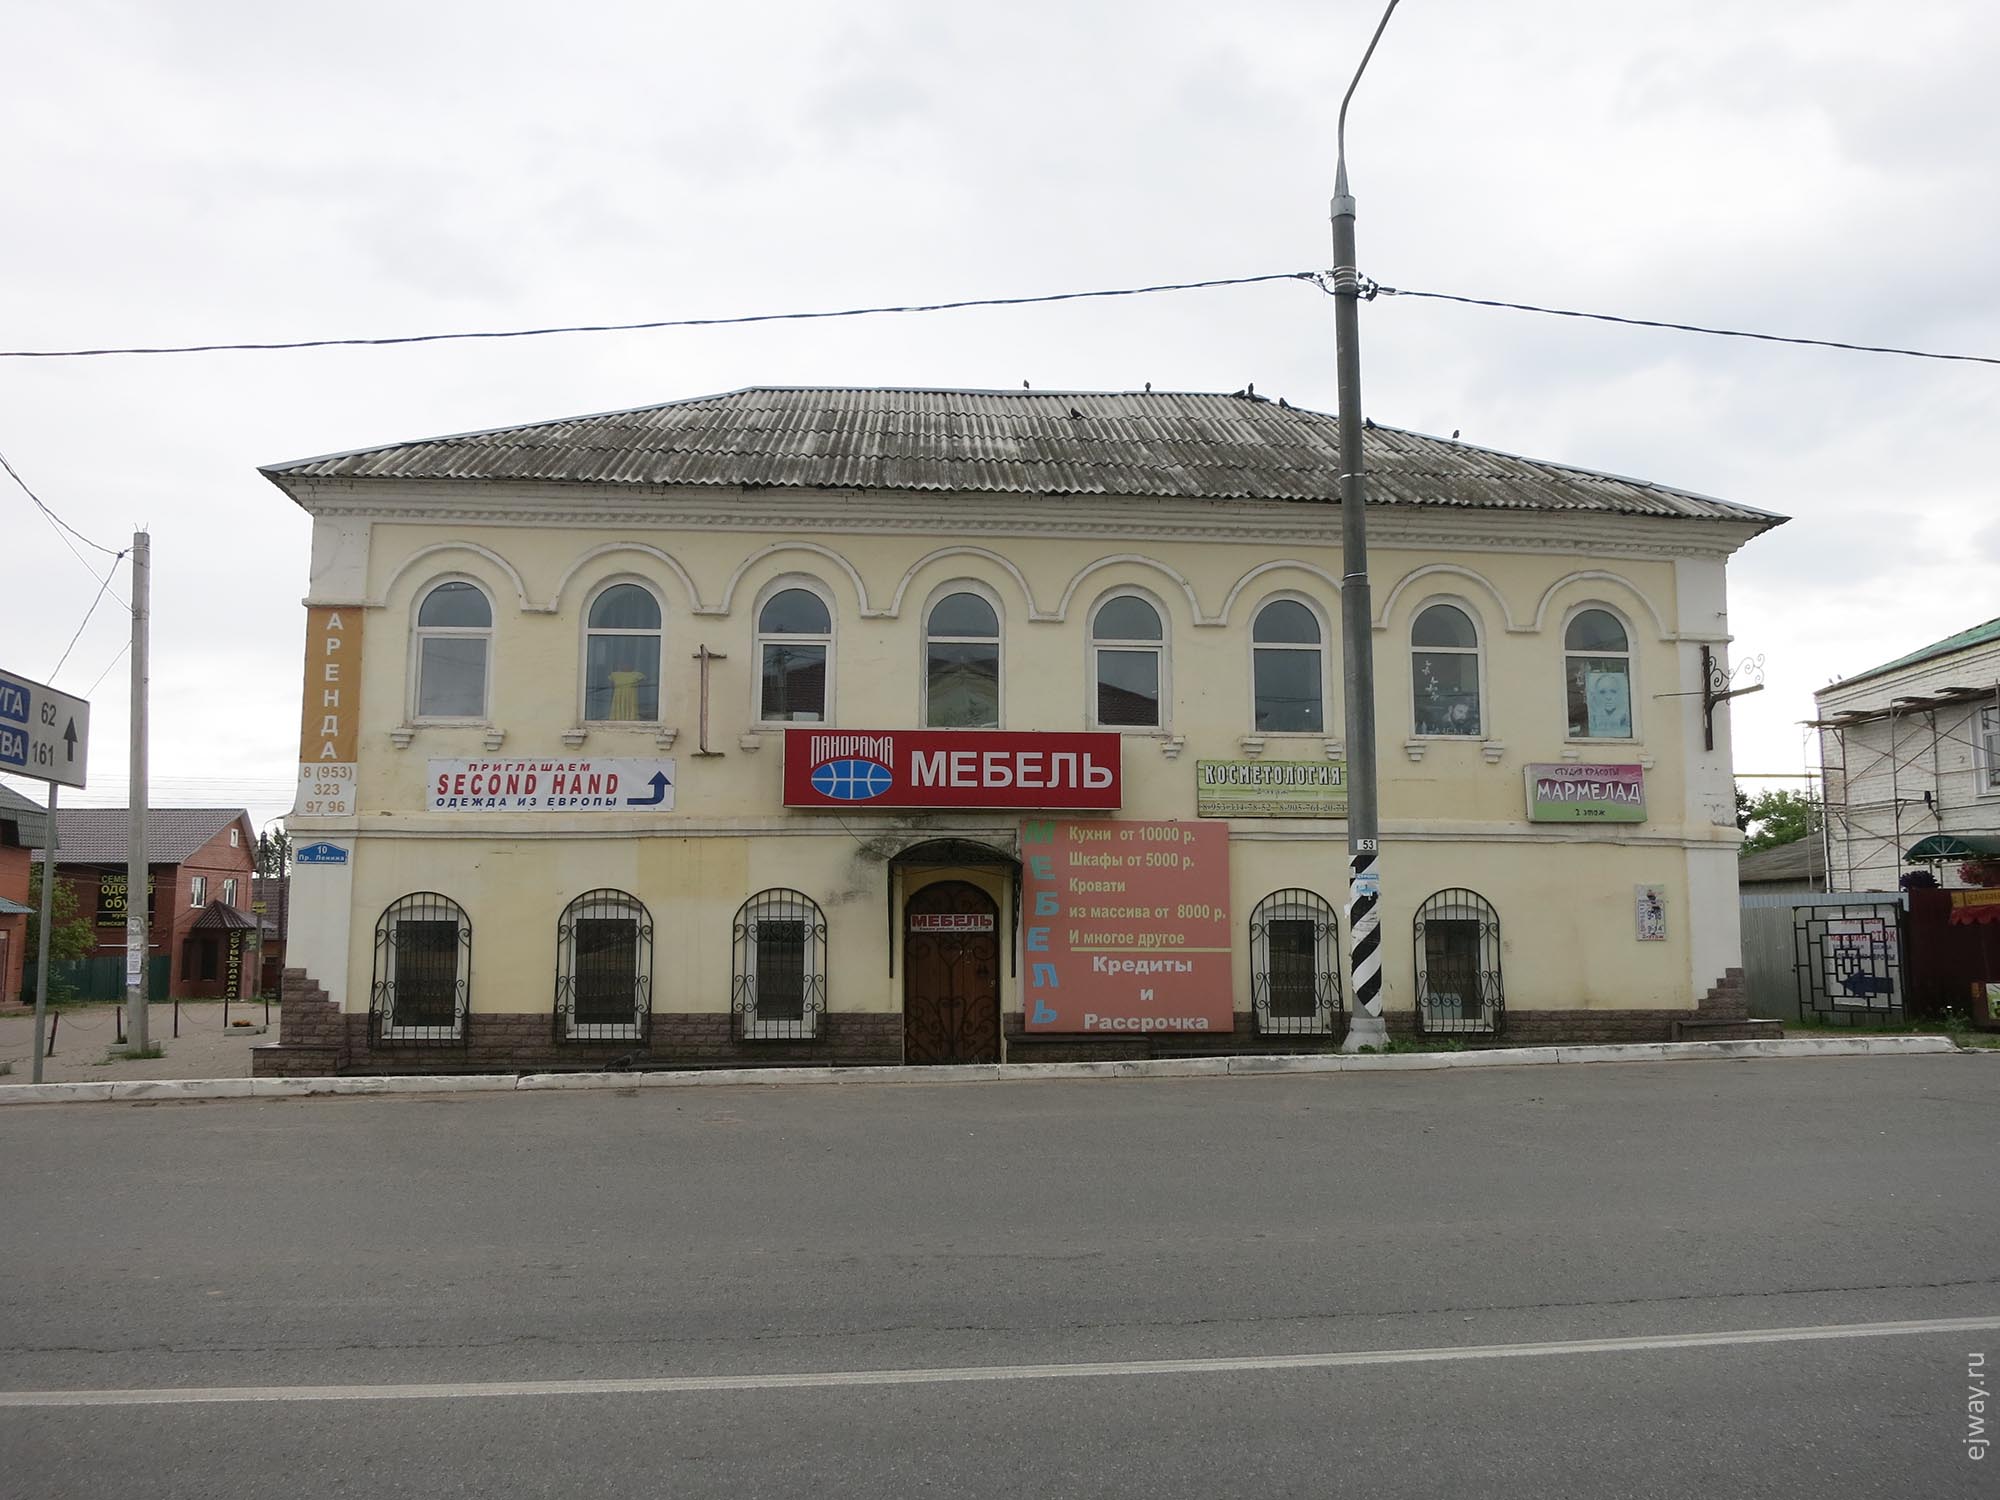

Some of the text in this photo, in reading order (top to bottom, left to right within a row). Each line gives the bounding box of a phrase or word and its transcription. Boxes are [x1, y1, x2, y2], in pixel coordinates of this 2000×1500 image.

[319, 612, 344, 760] АРЕНДА
[41, 702, 57, 727] 62
[32, 741, 54, 767] 161
[810, 735, 894, 769] ПАНОРАМА
[303, 766, 353, 781] 8 (953)
[468, 763, 592, 772] ПРИГЛАШАЕМ
[911, 750, 1114, 789] МЕБЕЛЬ
[1205, 765, 1342, 785] КОСМЕТОЛОГИЯ
[313, 783, 340, 796] 323
[437, 774, 619, 795] SECOND HAND
[1537, 782, 1641, 804] МАРМЕЛАД
[306, 801, 345, 813] 97 96
[436, 797, 617, 808] ОДЕЖДА ИЗ ЕВРОПЫ
[1069, 826, 1196, 844] Кухни от 10000 р.
[317, 846, 328, 854] 10
[1362, 840, 1374, 849] 53
[1069, 852, 1195, 870] Шкафы от 5000 р.
[1069, 878, 1126, 895] Кровати
[911, 915, 993, 927] МЕБЕЛЬ
[1069, 904, 1226, 922] из массива от 8000 р.
[1024, 821, 1060, 1025] МЕБЕЛЬ
[1069, 930, 1185, 947] И многое другое
[1093, 956, 1193, 975] Кредиты
[1141, 989, 1153, 1000] и
[1084, 1014, 1209, 1032] Рассрочка
